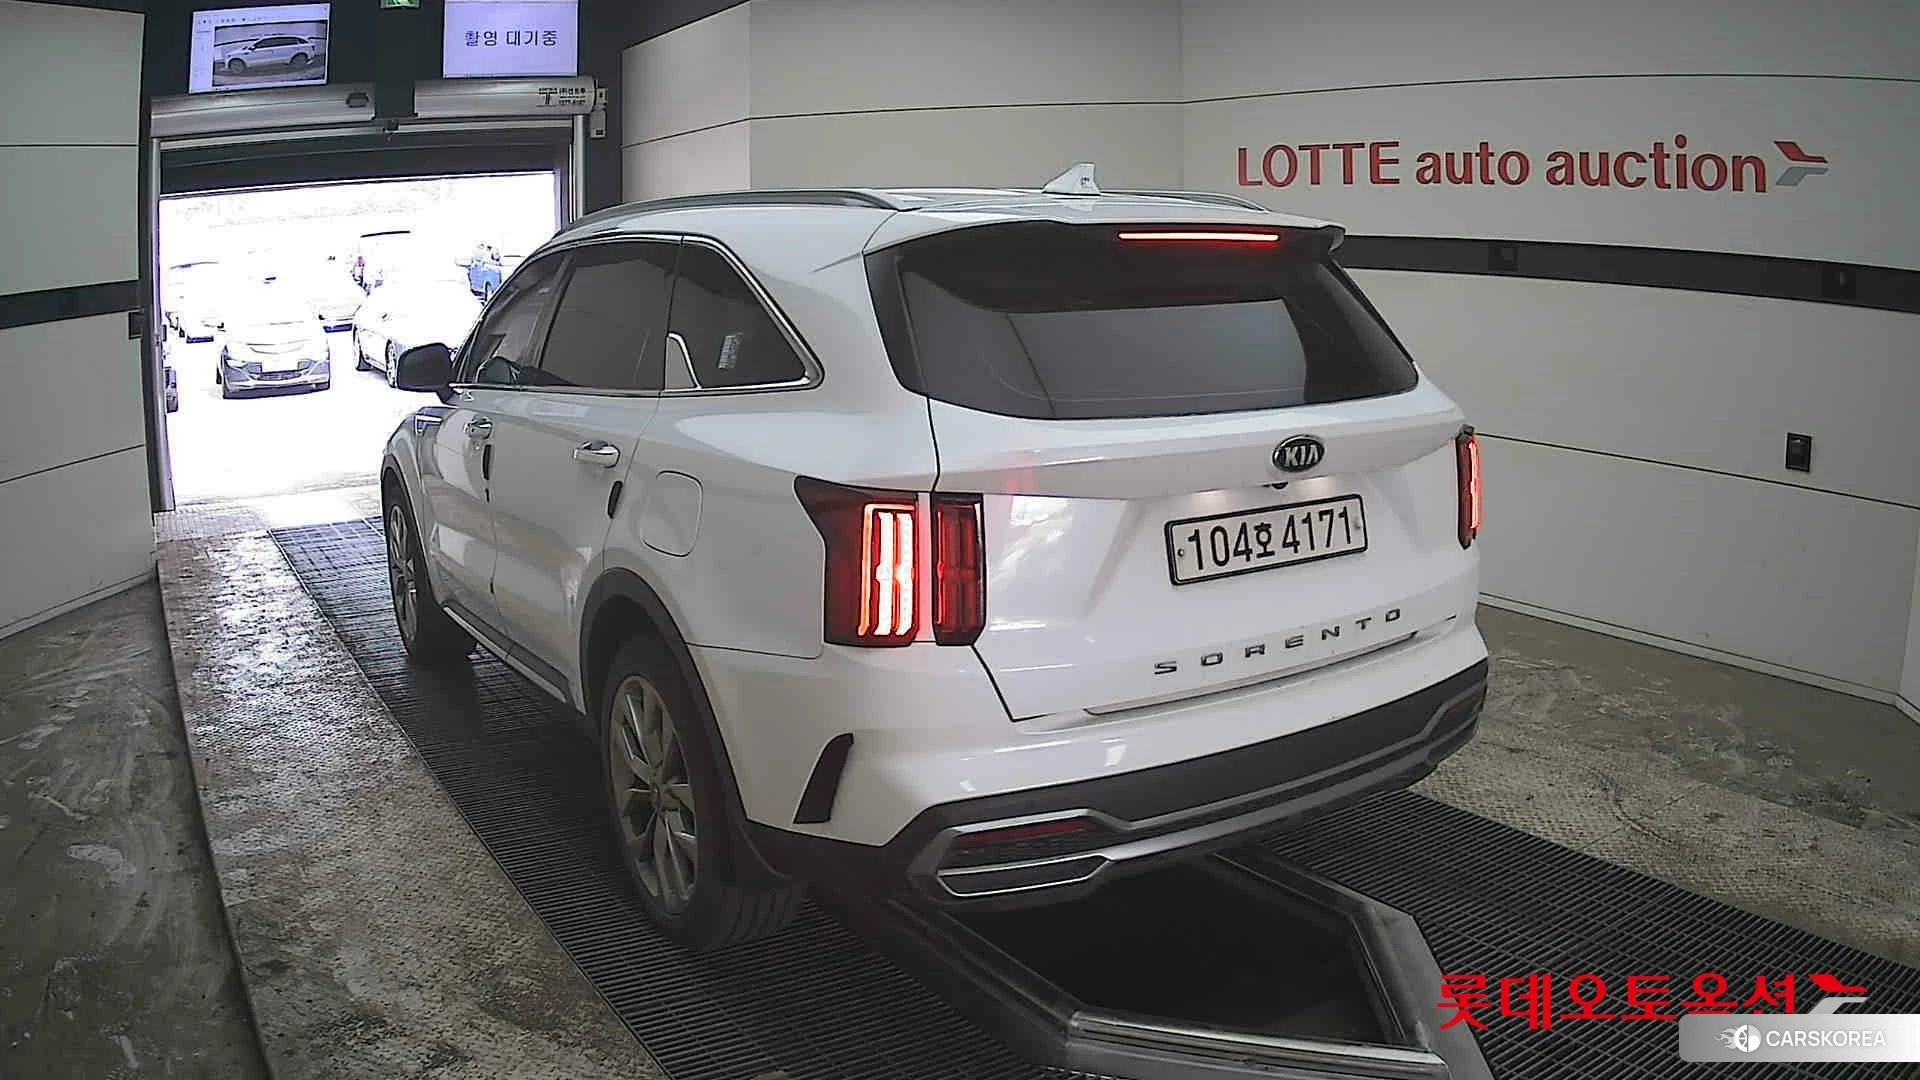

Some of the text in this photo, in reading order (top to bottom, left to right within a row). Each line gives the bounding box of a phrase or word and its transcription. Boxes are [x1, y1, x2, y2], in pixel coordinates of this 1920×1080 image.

[506, 30, 558, 47] 대기중
[1237, 134, 1767, 193] LOTTE auto auction
[1284, 444, 1319, 467] KIA
[1187, 505, 1352, 571] 104호 4171
[1154, 608, 1402, 675] SORENTO
